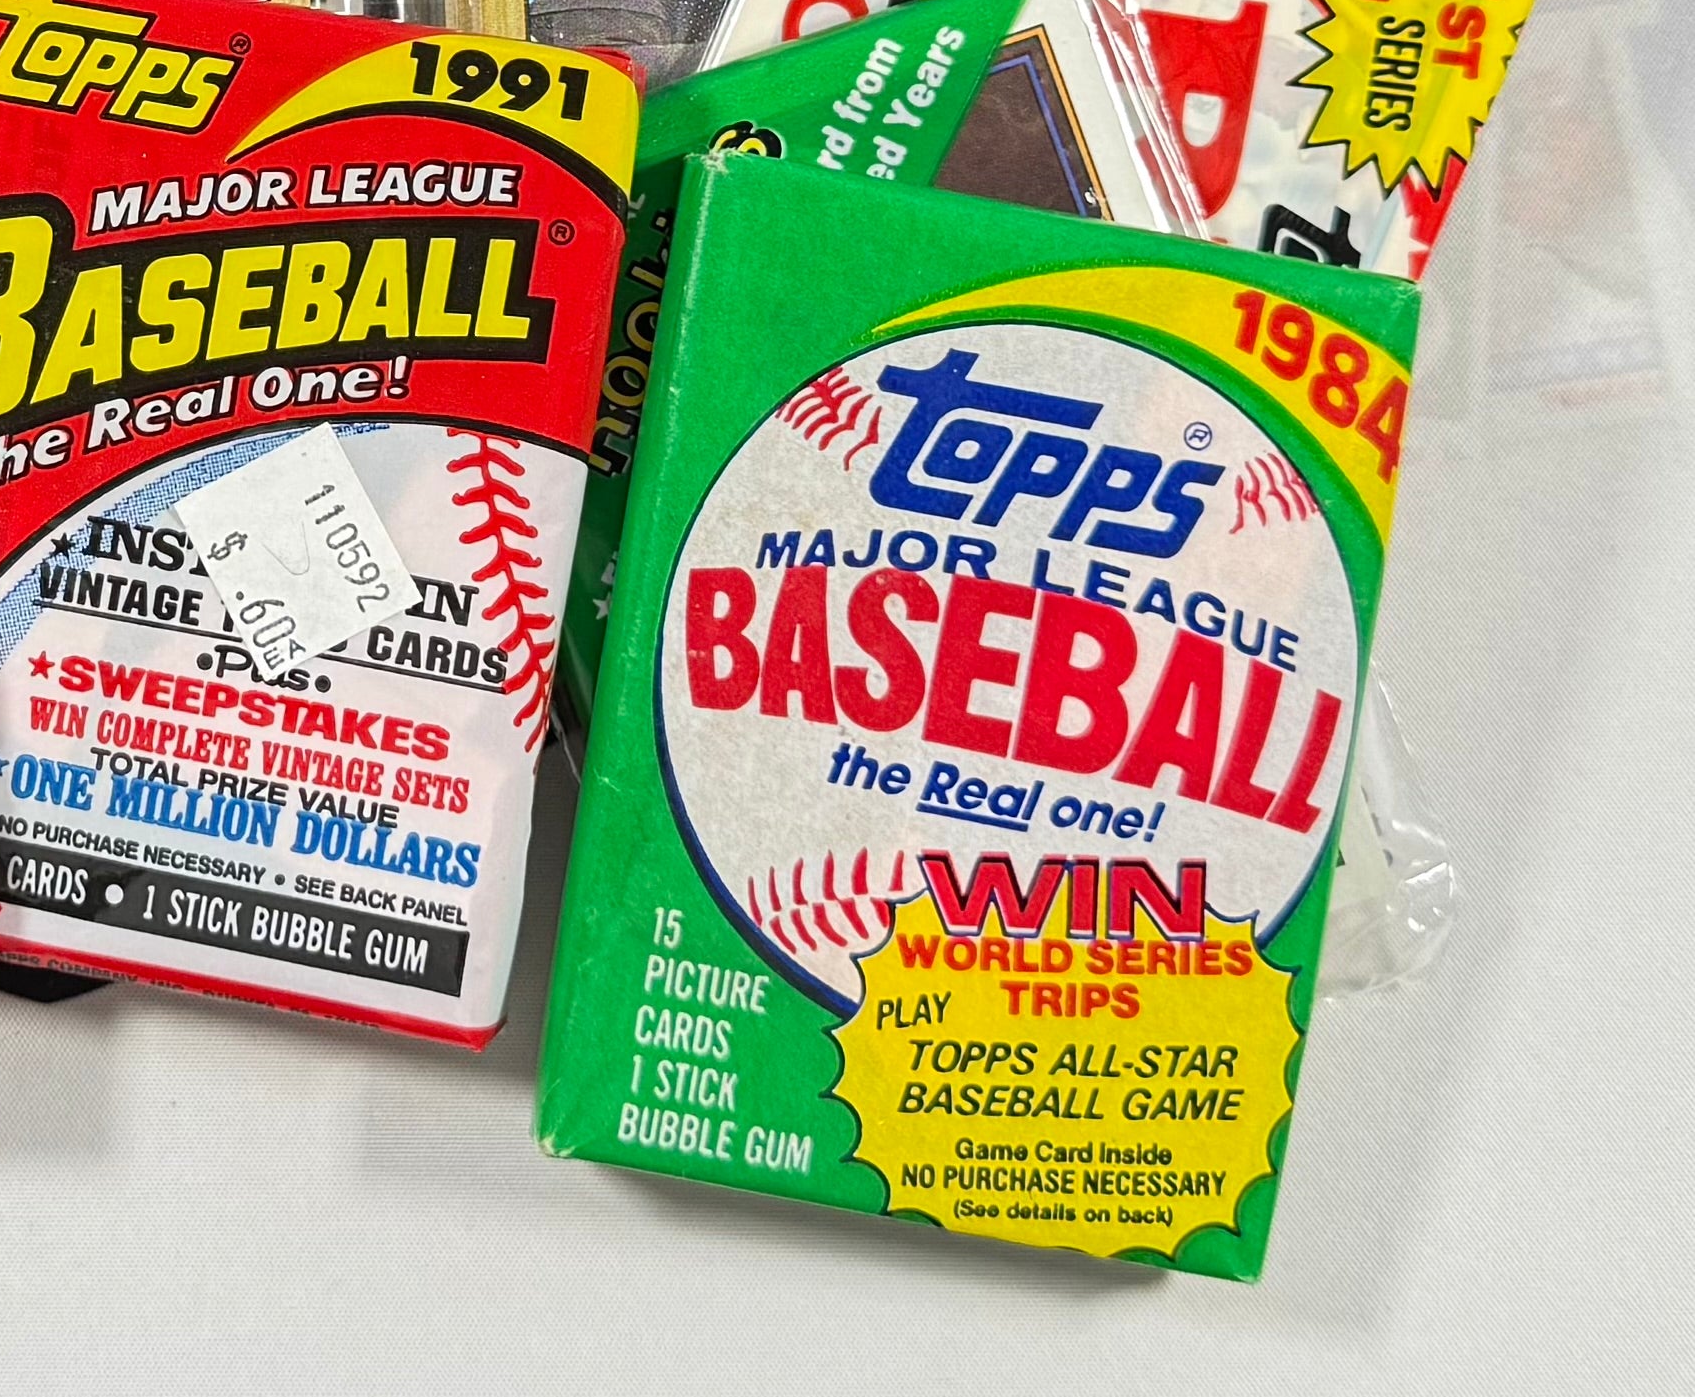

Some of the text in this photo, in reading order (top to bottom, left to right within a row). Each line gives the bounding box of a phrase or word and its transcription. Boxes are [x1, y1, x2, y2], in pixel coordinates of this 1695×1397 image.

[410, 41, 590, 121] 1991
[834, 37, 905, 123] from
[883, 24, 966, 130] Years
[1363, 16, 1427, 132] SERIES
[91, 163, 521, 234] MAJOR LEAGUE
[90, 370, 232, 450] Real
[251, 356, 409, 409] One!
[1233, 289, 1409, 485] 1984
[304, 484, 390, 614] 110592
[39, 561, 204, 627] VINTAGE
[367, 625, 509, 684] CARDS
[756, 530, 1300, 674] MAJOR LEAGUE
[59, 654, 451, 761] SWEEPSTAKES
[686, 564, 1342, 835] BASEBALL
[29, 696, 470, 813] WIN COMPLETE VINTAGE SETS
[89, 746, 401, 830] TOTAL PRIZE VALUE
[828, 743, 1166, 844] the Real one!
[11, 752, 482, 889] ONE MILLION DOLLARS
[32, 820, 140, 864] PURCHASE
[144, 843, 268, 886] NECESSARY
[294, 873, 337, 899] SEE
[340, 883, 398, 912] BACK
[401, 893, 470, 927] PANEL
[919, 848, 1208, 942] WIN
[7, 857, 89, 906] CARDS
[142, 884, 155, 921] 1
[167, 890, 242, 939] STICK
[250, 908, 355, 963] BUBBLE
[364, 928, 430, 976] GUM
[652, 906, 683, 948] 15
[896, 934, 1254, 978] WORLD SERIES
[644, 954, 771, 1015] PICTURE
[876, 991, 952, 1031] PLAY
[1000, 981, 1141, 1019] TRIPS
[634, 1004, 733, 1058] CARDS
[908, 1037, 1239, 1079] TOPPS ALL-STAR
[629, 1055, 738, 1111] 1 STICK
[897, 1082, 1243, 1123] BASEBALL GAME
[618, 1104, 813, 1174] BUBBLE GUM
[900, 1164, 1228, 1198] NO PURCHASE NECESSARY
[954, 1137, 1174, 1168] Game Card Inside
[953, 1198, 1175, 1227] (See details on back)
